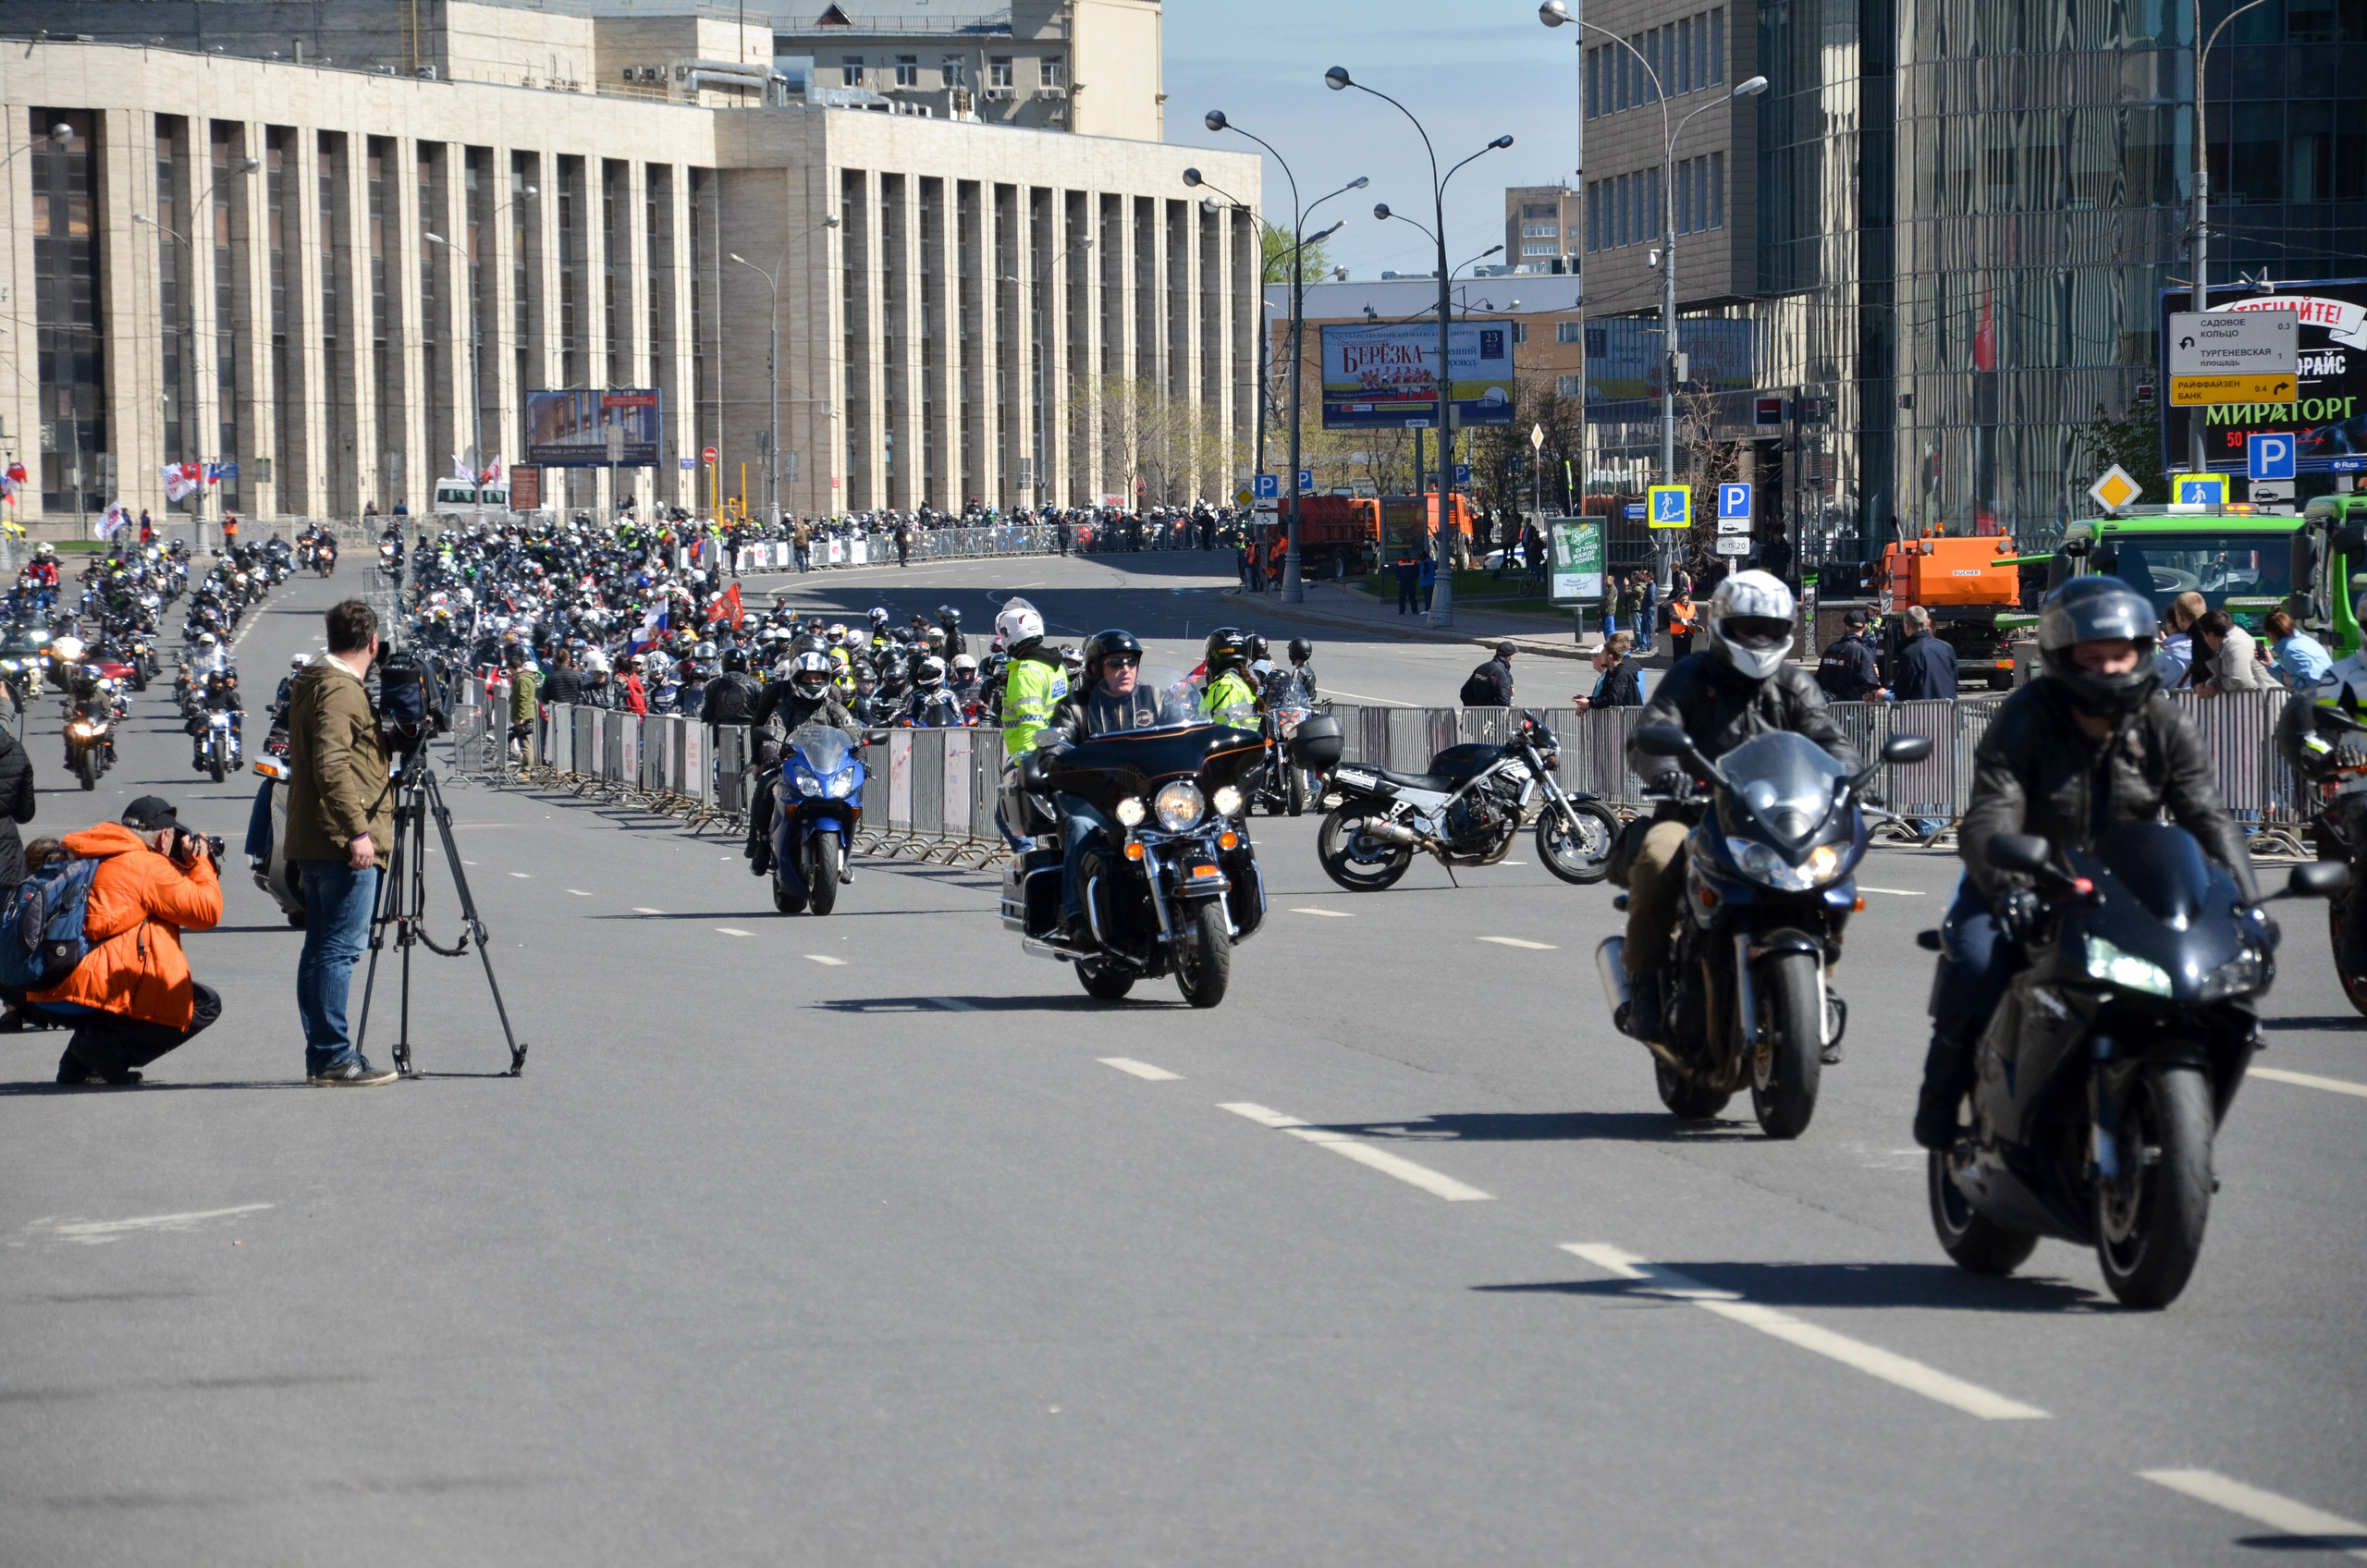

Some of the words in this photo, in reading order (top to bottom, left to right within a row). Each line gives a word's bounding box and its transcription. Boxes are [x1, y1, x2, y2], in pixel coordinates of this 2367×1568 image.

[2201, 319, 2246, 327] САДОВОЕ
[2277, 323, 2291, 331] 0.3
[1485, 332, 1499, 343] 23
[2201, 330, 2239, 338] КОЛЬЦО
[1343, 342, 1423, 374] БЕРЁЗКА
[2201, 349, 2272, 358] ТУРГЕНЕВСКАЯ
[2177, 380, 2240, 389] РАЙФФАЙЗЕН
[2254, 385, 2267, 393] 0.4
[2177, 392, 2202, 400] БАНК
[2205, 396, 2357, 426] МИРАТОРГ
[2226, 431, 2243, 447] 50
[2261, 439, 2287, 474] P
[1260, 477, 1274, 496] P
[1727, 487, 1746, 514] P
[1574, 526, 1595, 543] Sprite
[1728, 541, 1735, 549] 15
[1735, 542, 1746, 550] 20
[1573, 550, 1596, 560] ЖАЖДЕ
[1575, 556, 1595, 564] КОНЕЦ
